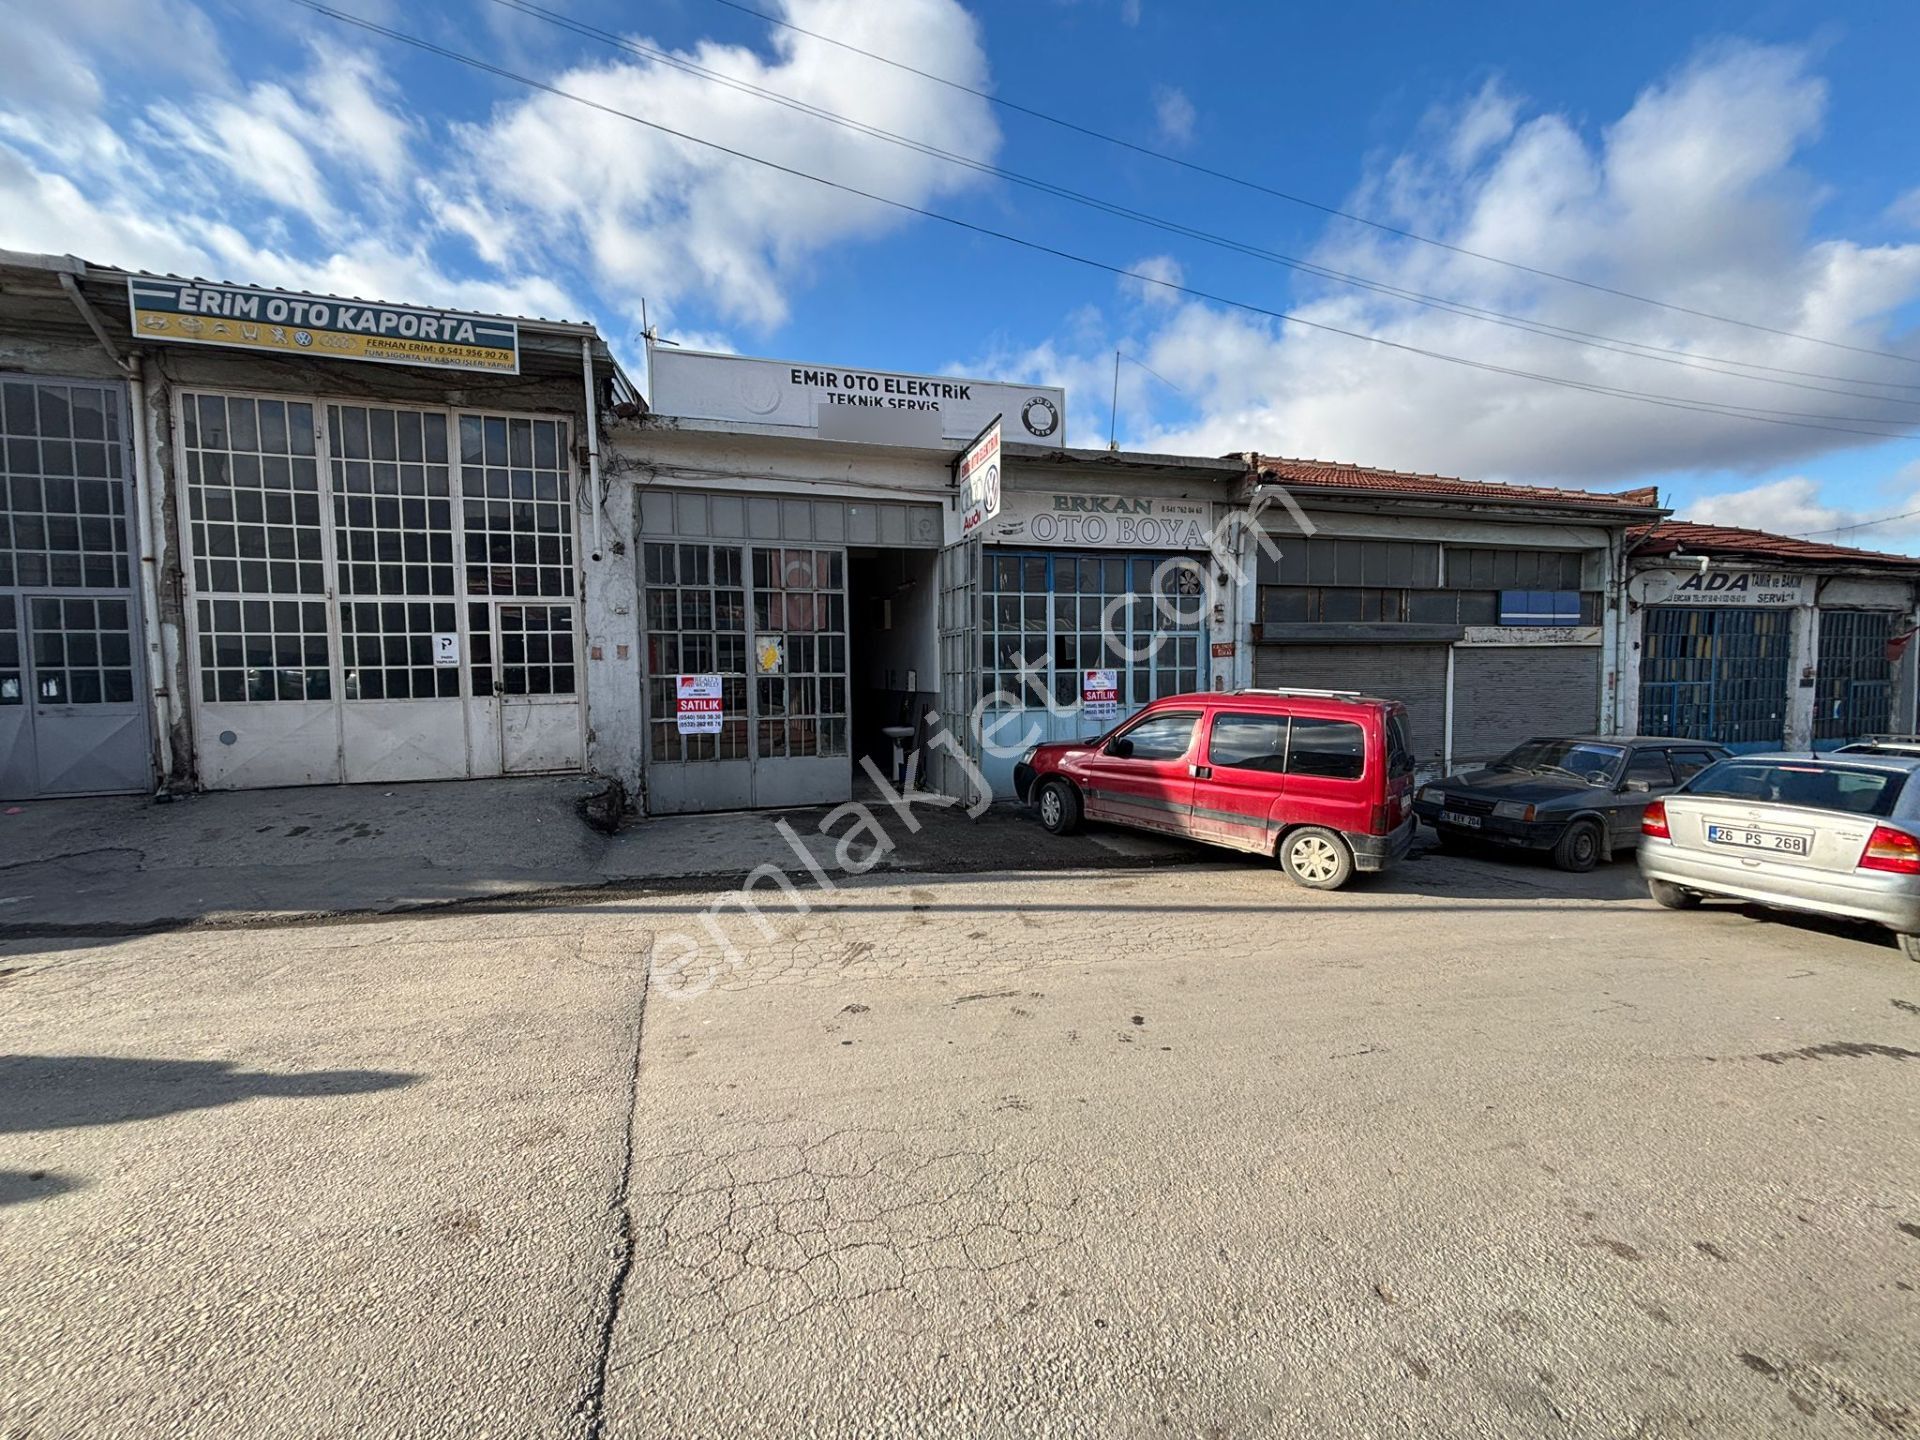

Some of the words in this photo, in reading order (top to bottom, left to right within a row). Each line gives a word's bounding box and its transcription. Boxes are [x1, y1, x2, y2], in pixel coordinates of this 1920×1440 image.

[266, 299, 330, 327] OTO
[336, 307, 476, 343] KAPORTA
[366, 339, 407, 350] FERHAN
[447, 347, 463, 355] 541
[466, 350, 483, 358] 956
[485, 351, 496, 359] 90
[498, 352, 509, 360] 76
[843, 374, 879, 392] OTO
[1030, 427, 1051, 437] AUTO
[1053, 495, 1153, 515] ERKAN
[963, 508, 981, 532] Audi
[1030, 514, 1107, 543] OTO
[1116, 517, 1206, 547] BOYA
[1678, 573, 1750, 592] ADA
[680, 700, 719, 710] SATILIK
[1086, 691, 1115, 700] SATILIK
[1717, 829, 1733, 842] 26
[1745, 833, 1762, 845] PS
[1775, 836, 1801, 850] 268
